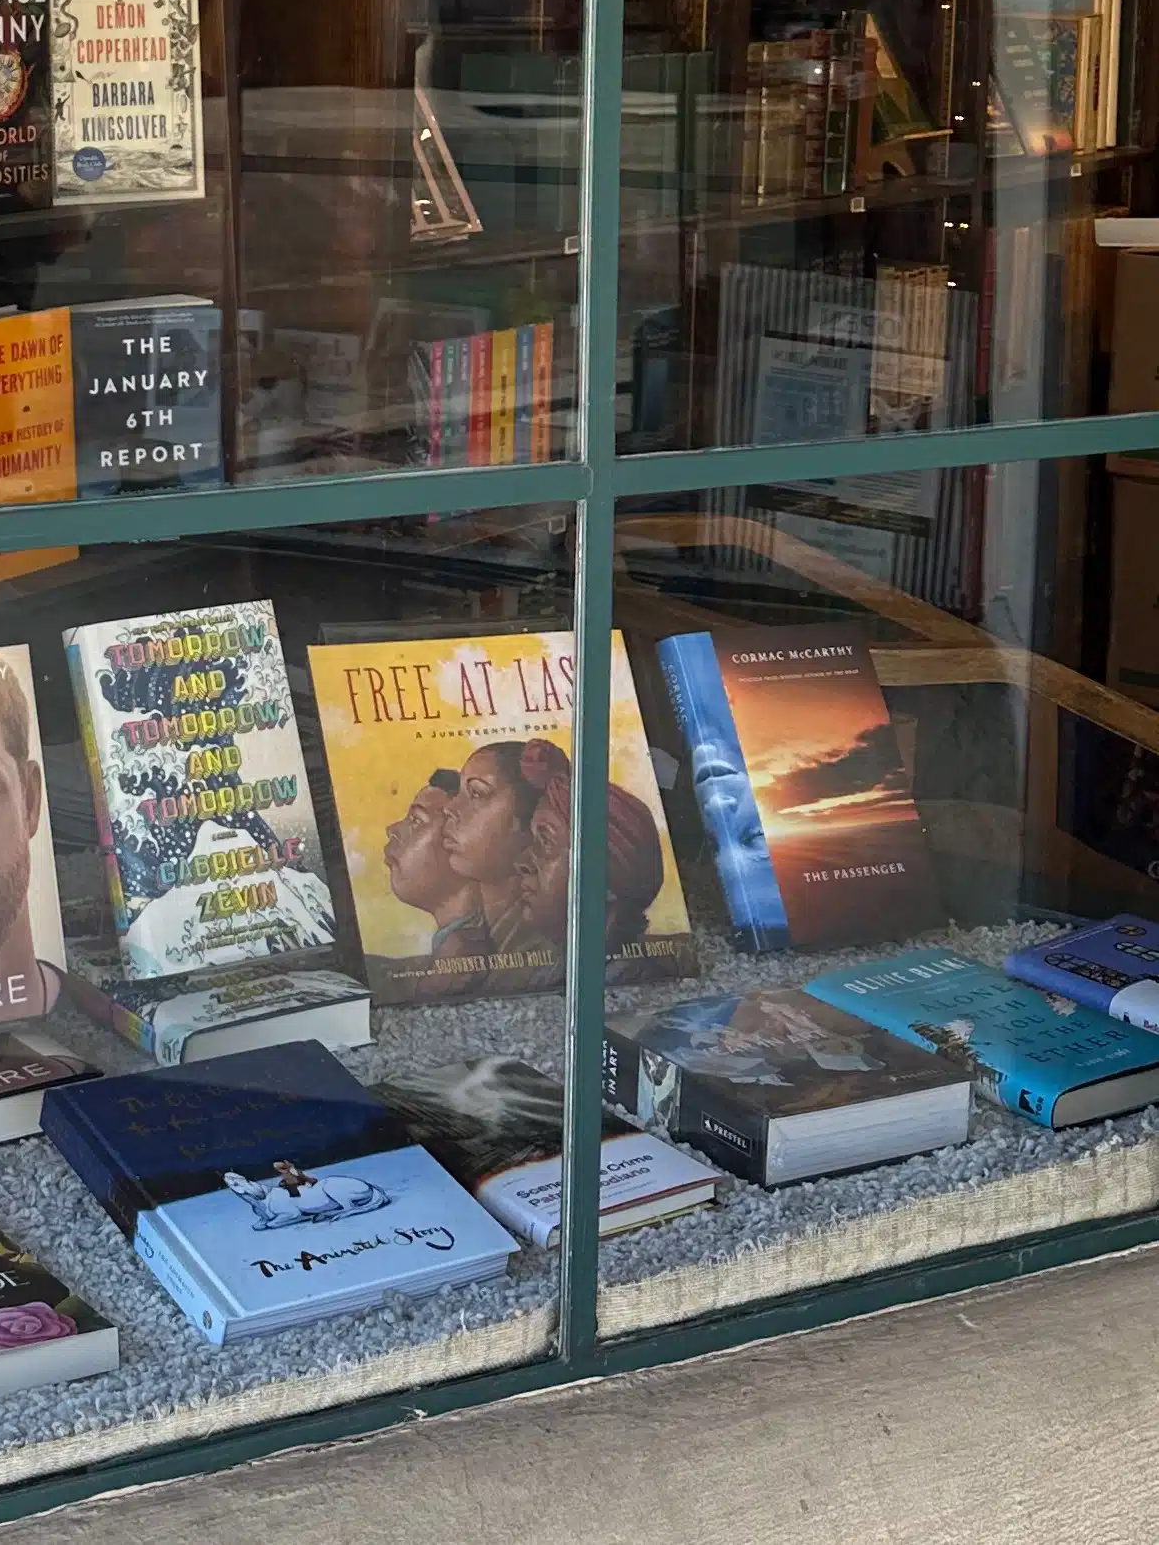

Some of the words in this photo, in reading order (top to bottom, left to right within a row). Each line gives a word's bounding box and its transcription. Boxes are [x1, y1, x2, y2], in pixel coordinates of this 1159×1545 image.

[96, 3, 146, 29] DEMON
[77, 37, 167, 64] COPPERHEAD
[93, 81, 155, 107] BARBARA
[82, 114, 167, 142] KINGSOLVER
[11, 339, 46, 365] DAWN
[50, 333, 64, 355] OF
[123, 336, 172, 355] THE
[89, 369, 208, 395] JANUARY
[17, 422, 53, 441] HISTORY
[54, 418, 64, 433] OF
[127, 409, 173, 429] 6TH
[100, 442, 203, 468] REPORT
[732, 651, 784, 664] CORMAC
[789, 645, 852, 659] McCARTHY
[172, 670, 226, 702] AND
[186, 746, 242, 781] AND
[157, 838, 302, 891] GABRIELLE
[803, 870, 829, 884] THE
[833, 862, 906, 880] PASSENGER
[843, 971, 917, 995] OLIVIE
[908, 957, 976, 981] BLAKE
[993, 1015, 1045, 1032] YOU
[1005, 1033, 1034, 1047] IN
[1039, 1019, 1090, 1040] THE
[608, 1047, 619, 1073] ART
[607, 1077, 616, 1095] IN
[250, 1259, 295, 1278] The
[295, 1233, 392, 1272] Animated
[392, 1222, 456, 1250] Story
